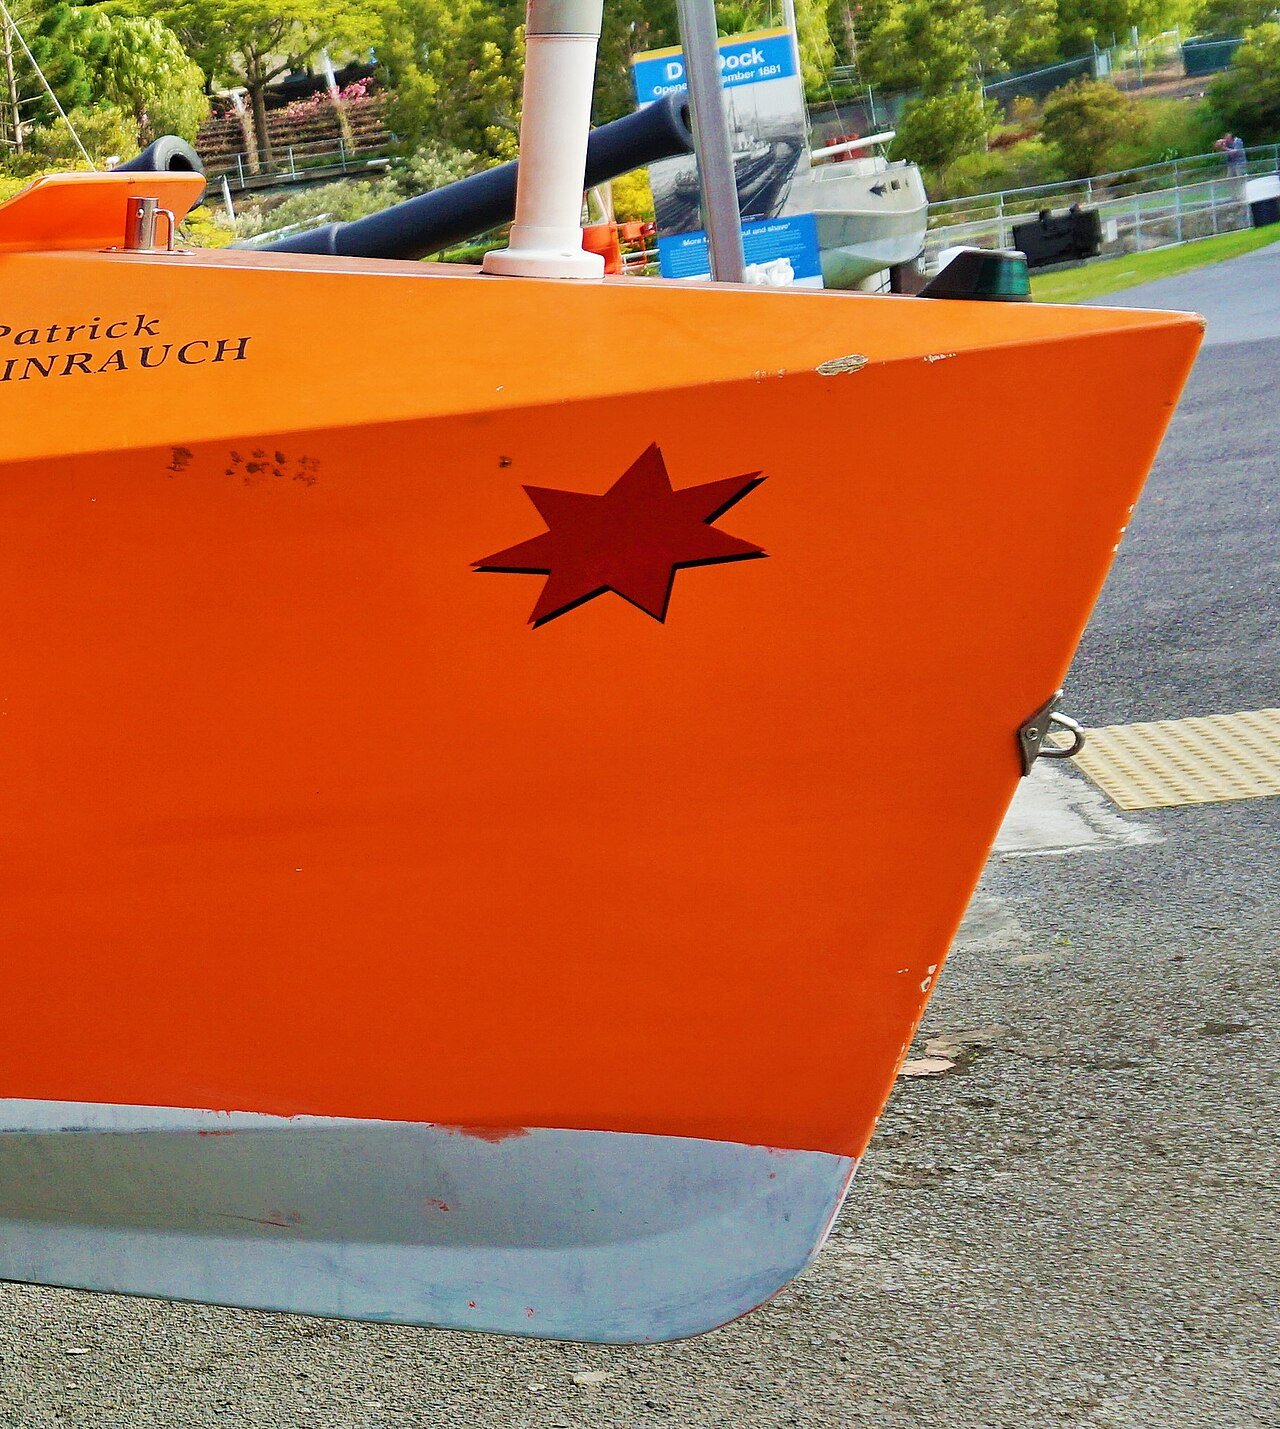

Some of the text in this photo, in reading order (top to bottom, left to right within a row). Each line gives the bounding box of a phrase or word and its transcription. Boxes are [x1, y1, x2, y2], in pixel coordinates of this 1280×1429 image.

[653, 63, 781, 96] Opene ember 1881
